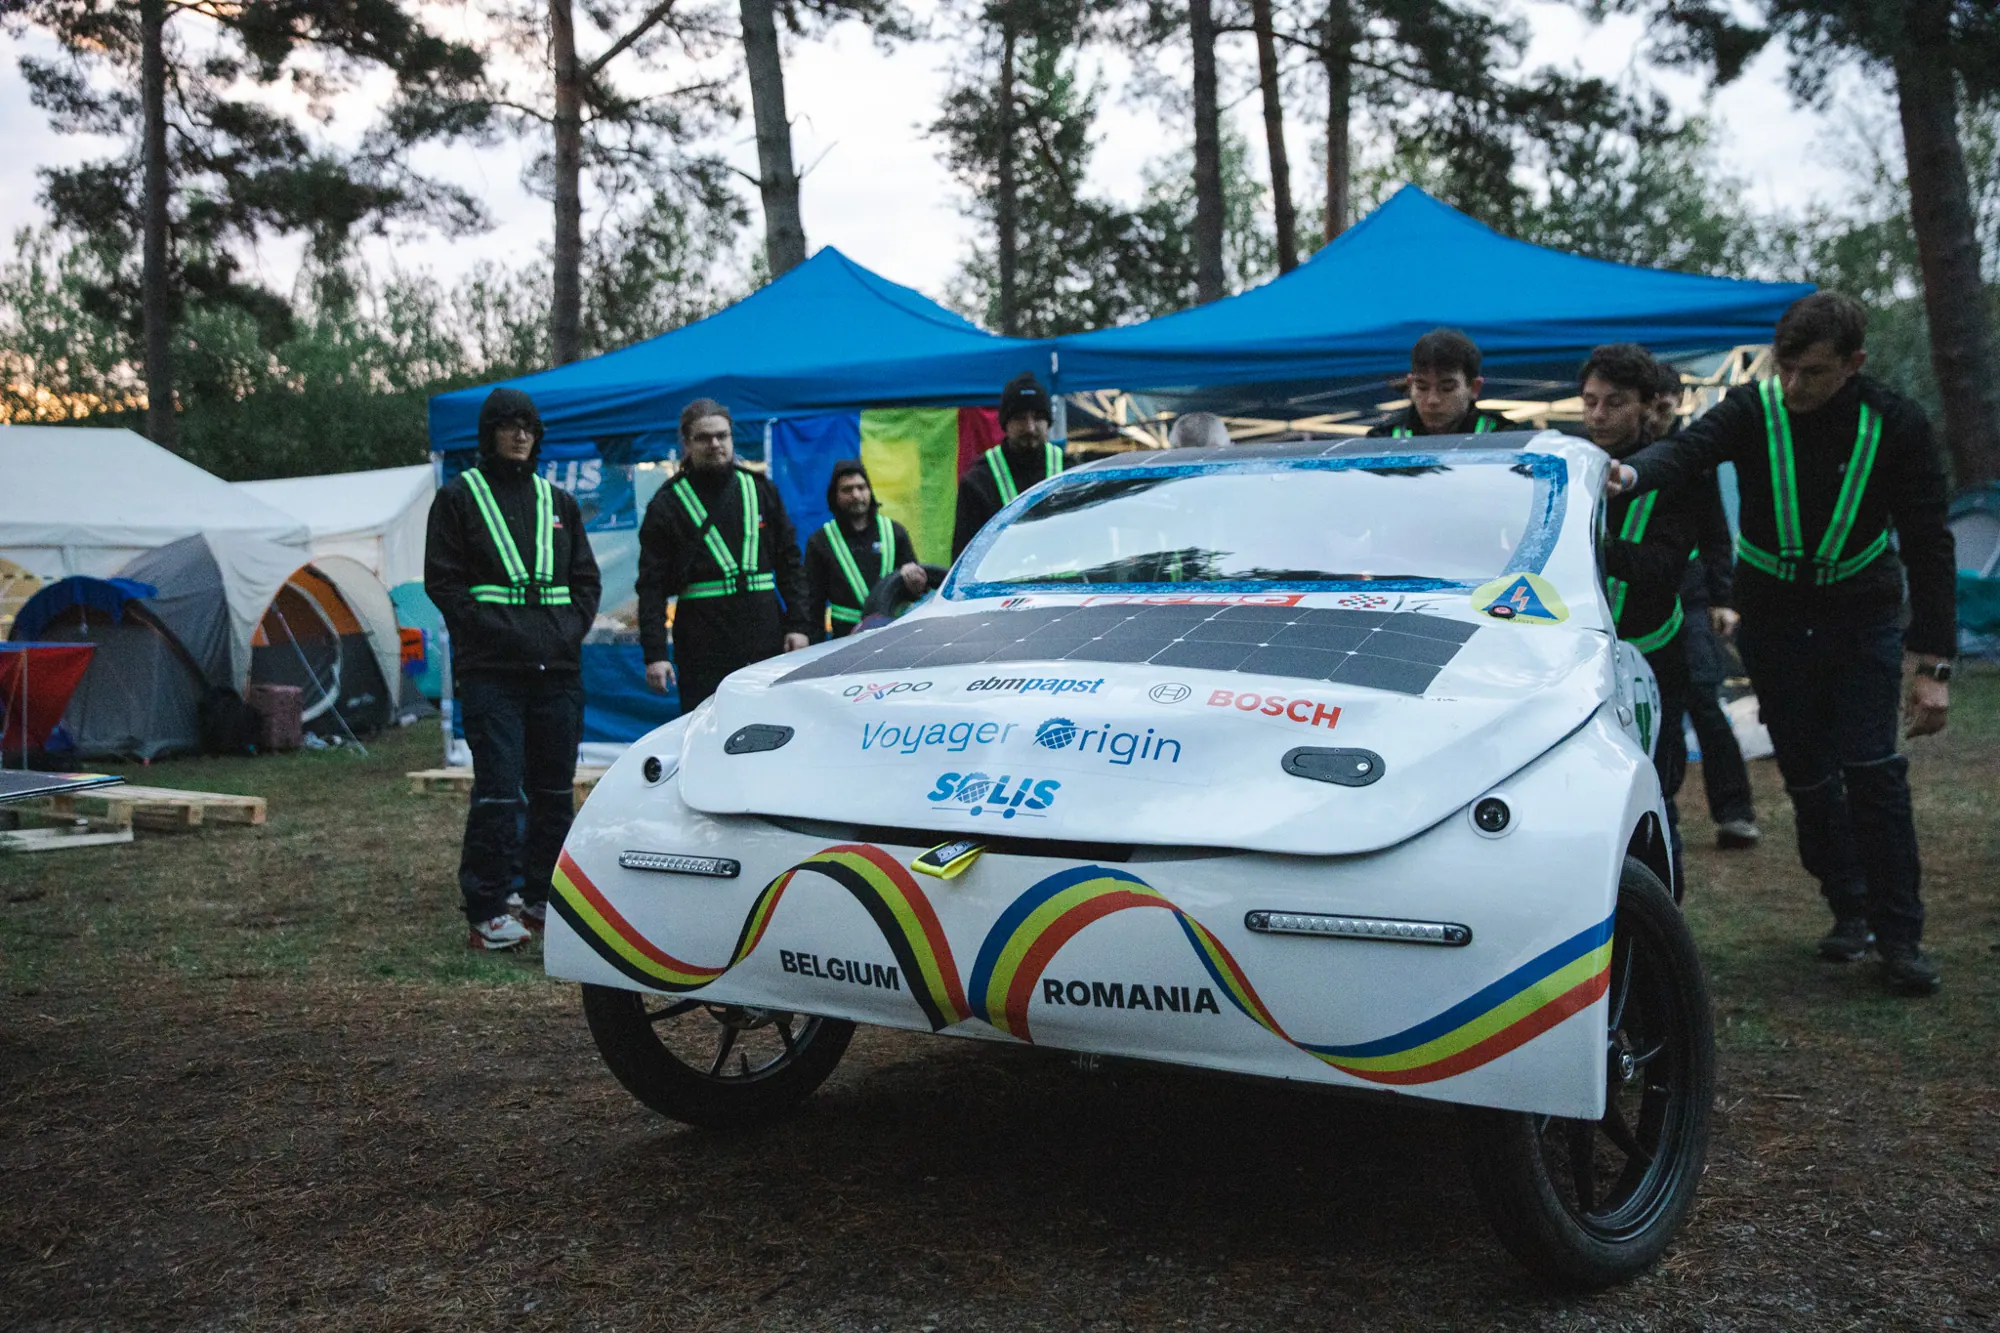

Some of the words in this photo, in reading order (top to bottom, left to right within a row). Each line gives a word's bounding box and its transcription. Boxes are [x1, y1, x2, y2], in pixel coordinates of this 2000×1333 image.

[545, 459, 602, 492] LIS
[966, 676, 1104, 695] ebmpapst
[1206, 689, 1342, 730] BOSCH
[861, 720, 1019, 755] Voyager
[926, 771, 1061, 810] SOLIS
[779, 948, 900, 991] BELGIUM
[1042, 978, 1221, 1015] ROMANIA
